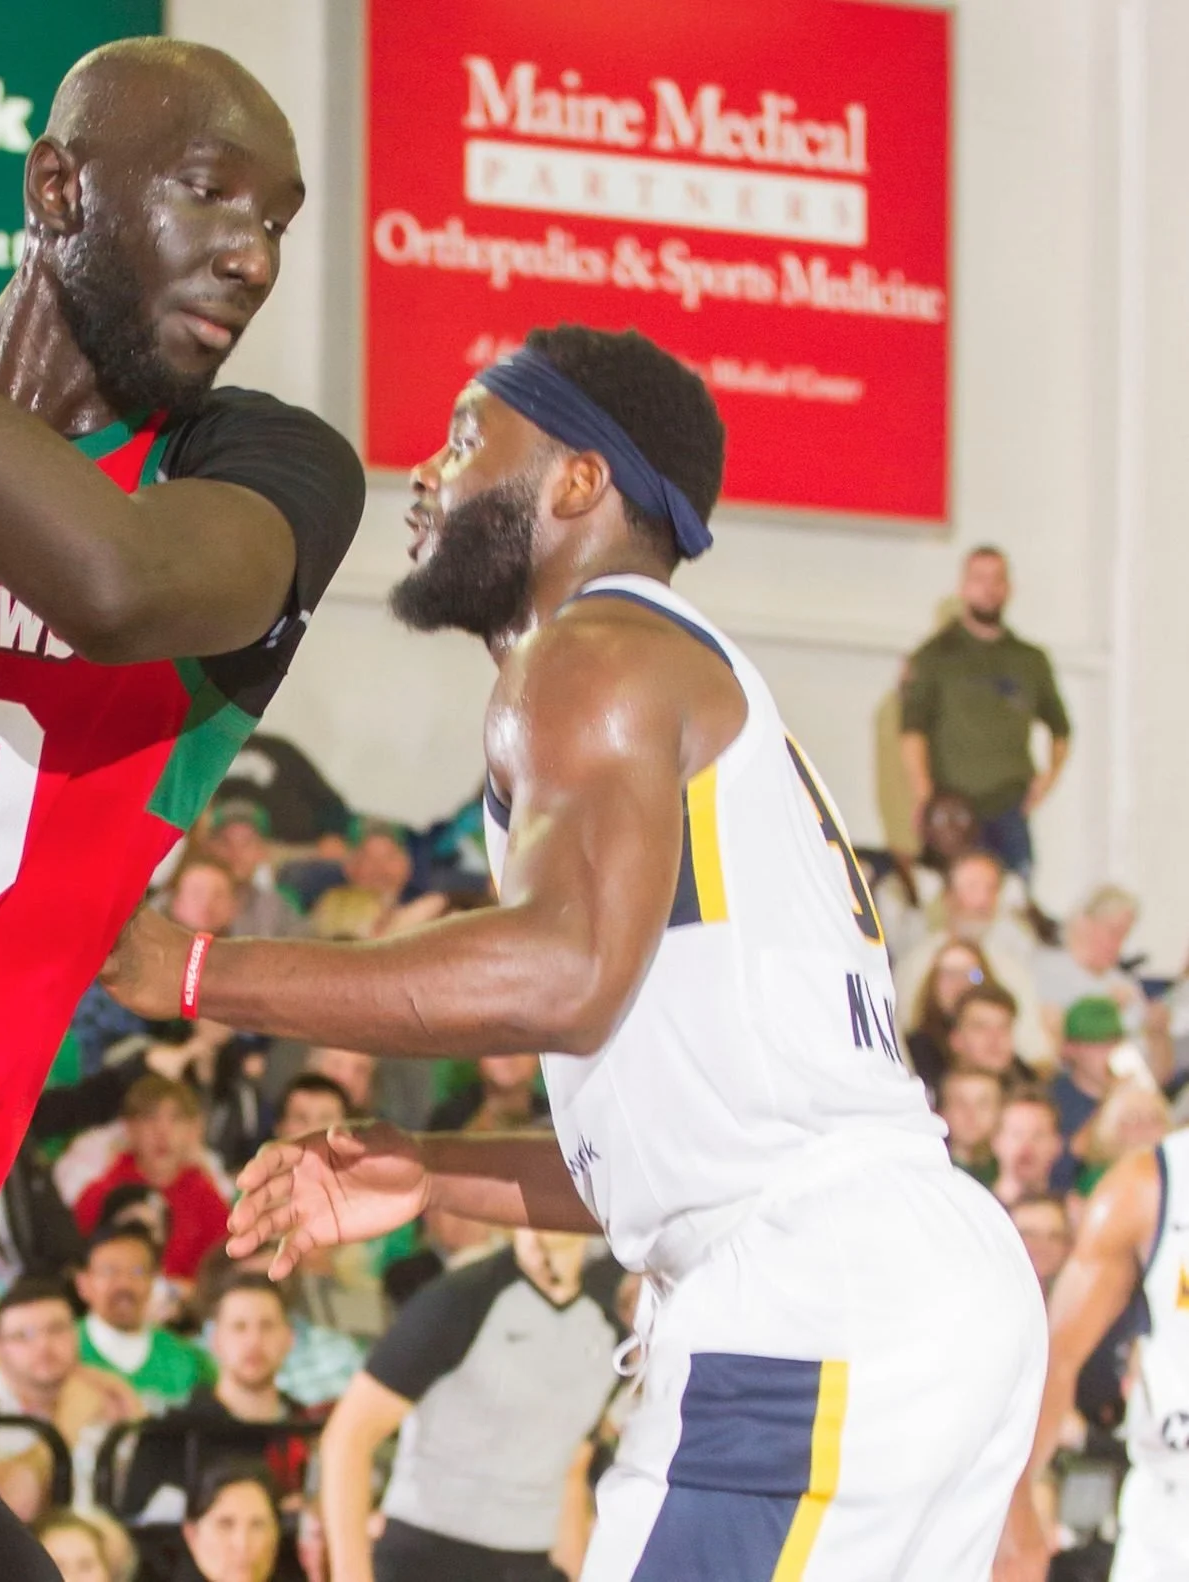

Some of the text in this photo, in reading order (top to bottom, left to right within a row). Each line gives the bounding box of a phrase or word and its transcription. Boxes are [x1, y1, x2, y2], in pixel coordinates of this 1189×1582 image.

[463, 55, 869, 176] Maine Medical
[482, 155, 854, 228] PARTNERS
[373, 209, 948, 325] Orthopedics & Sports Medicine
